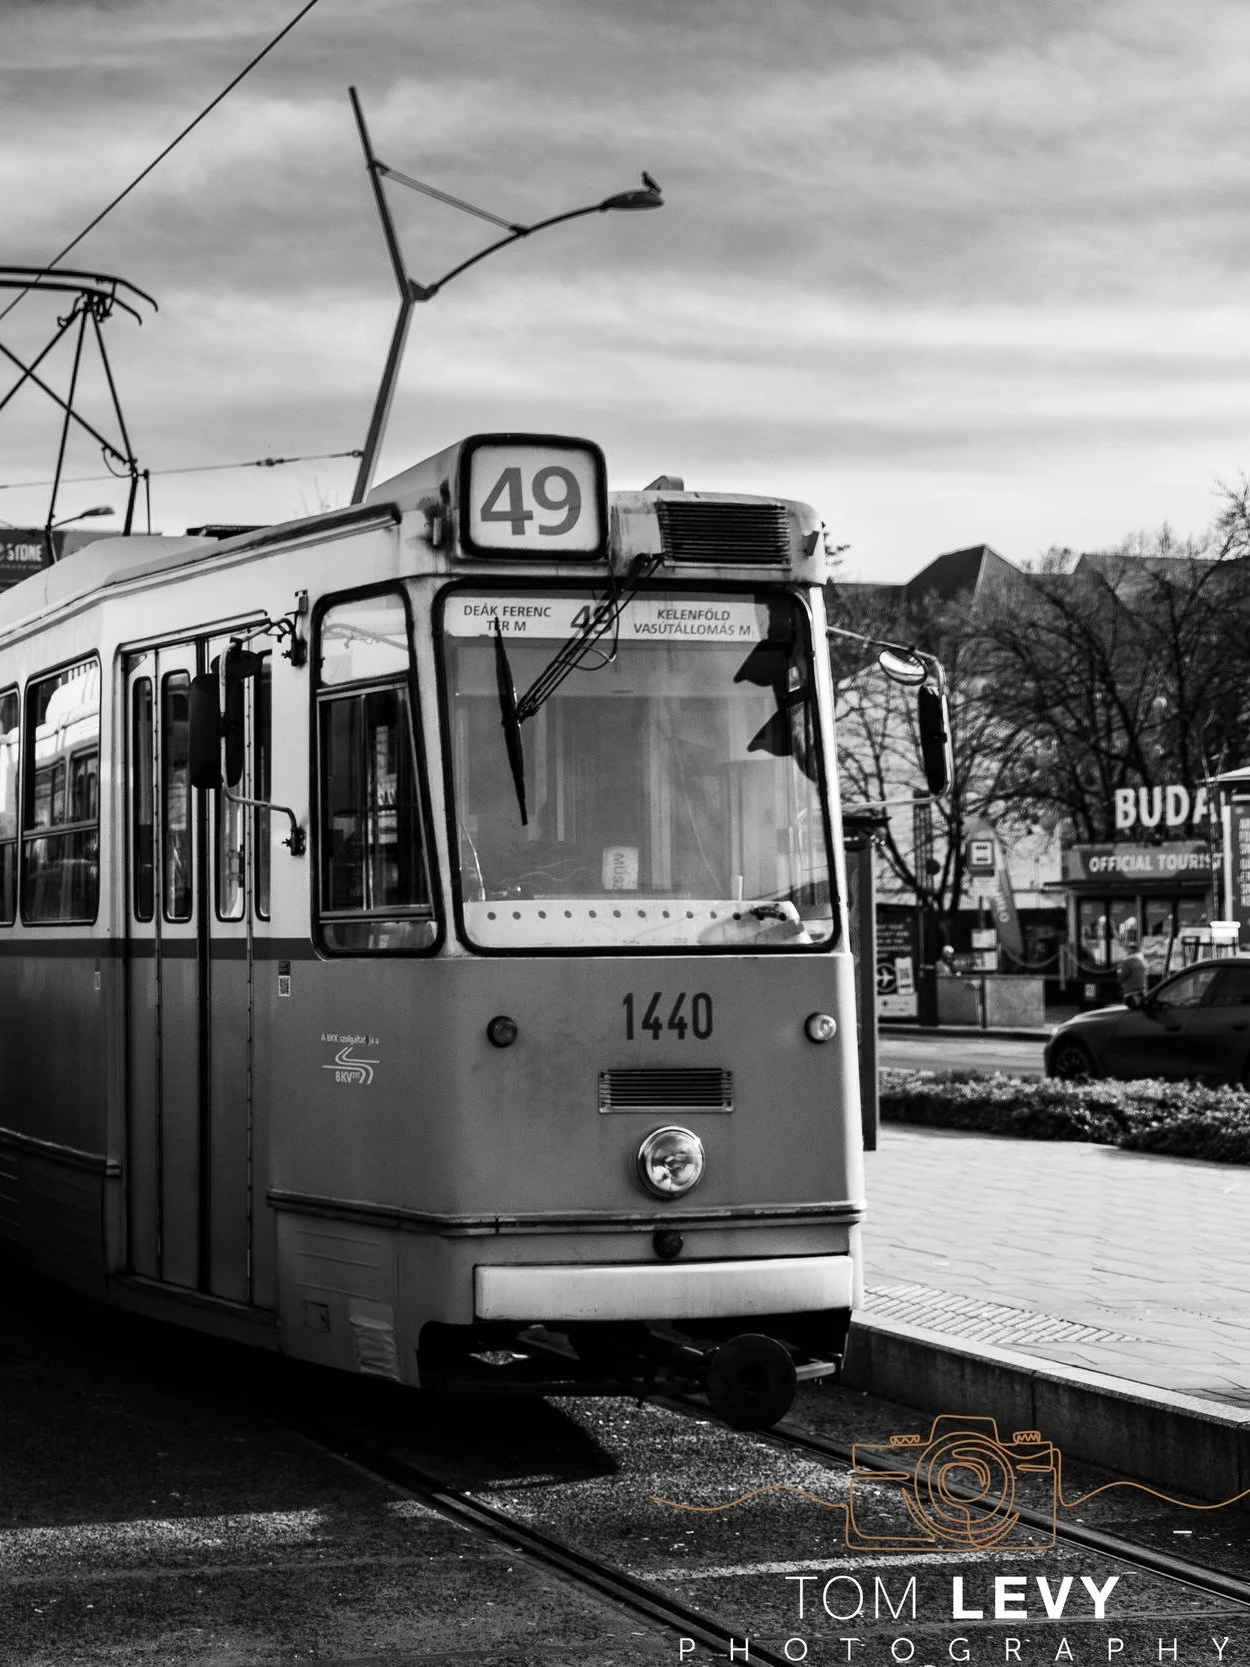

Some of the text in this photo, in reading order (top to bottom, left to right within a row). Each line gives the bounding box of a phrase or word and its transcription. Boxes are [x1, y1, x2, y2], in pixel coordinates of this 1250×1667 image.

[479, 466, 582, 537] 49
[463, 602, 552, 618] DEÁK FERENC
[570, 604, 615, 635] 49
[657, 608, 731, 621] KELENFÖLD
[514, 620, 527, 632] M
[633, 620, 751, 636] VASÚTÁLLOMÁS M
[1114, 785, 1226, 829] BUDA
[1088, 854, 1153, 873] OFFICIAL
[622, 991, 714, 1041] 1440
